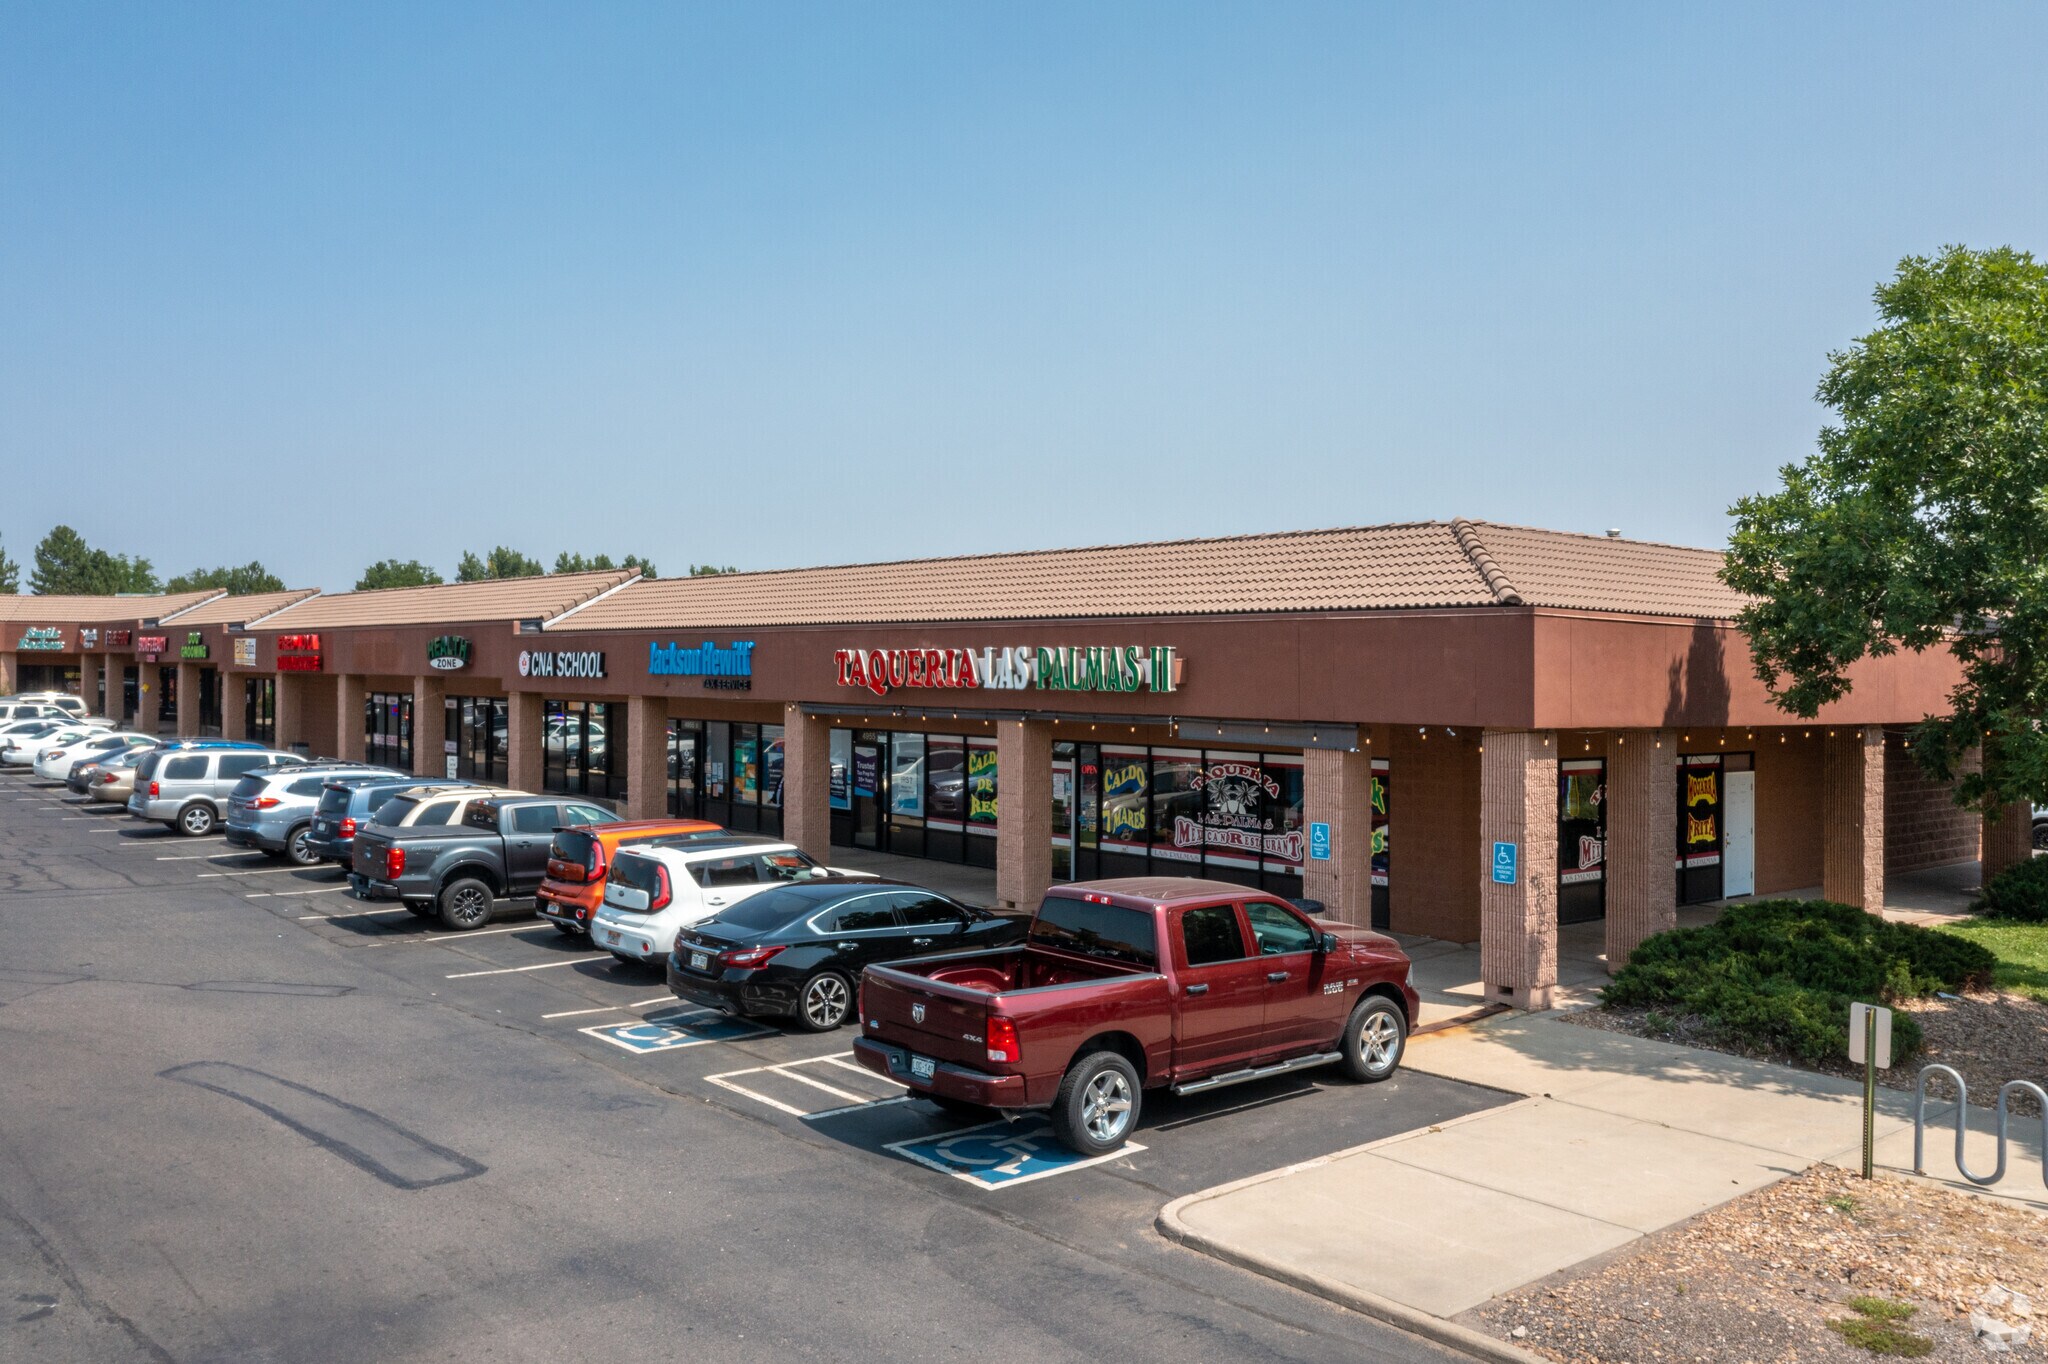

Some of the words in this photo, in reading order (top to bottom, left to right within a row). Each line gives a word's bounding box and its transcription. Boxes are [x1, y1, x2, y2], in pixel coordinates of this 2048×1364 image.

[427, 635, 469, 660] HEALTH
[648, 641, 702, 675] Jackson
[702, 641, 752, 676] Hewitt
[437, 659, 457, 668] ZONE
[531, 652, 553, 676] CNA
[556, 652, 604, 677] SCHOOL
[834, 648, 979, 696] TAQUERIA
[983, 646, 1029, 690] LAS
[1036, 645, 1141, 692] PALMAS
[1149, 646, 1174, 692] II
[703, 679, 716, 689] AX
[717, 680, 748, 690] SERVICE
[968, 751, 997, 774] CALD
[1081, 764, 1098, 775] OPEN
[977, 778, 993, 792] DE
[1104, 765, 1146, 792] CALDO
[970, 794, 998, 816] RES
[1102, 809, 1111, 832] 7
[1112, 807, 1146, 834] MARES
[1197, 812, 1220, 825] LAS
[1223, 815, 1274, 829] PALMAS
[1687, 812, 1716, 842] FRITA
[1177, 818, 1228, 846] MEXCAN
[1228, 831, 1301, 858] RESTURANT
